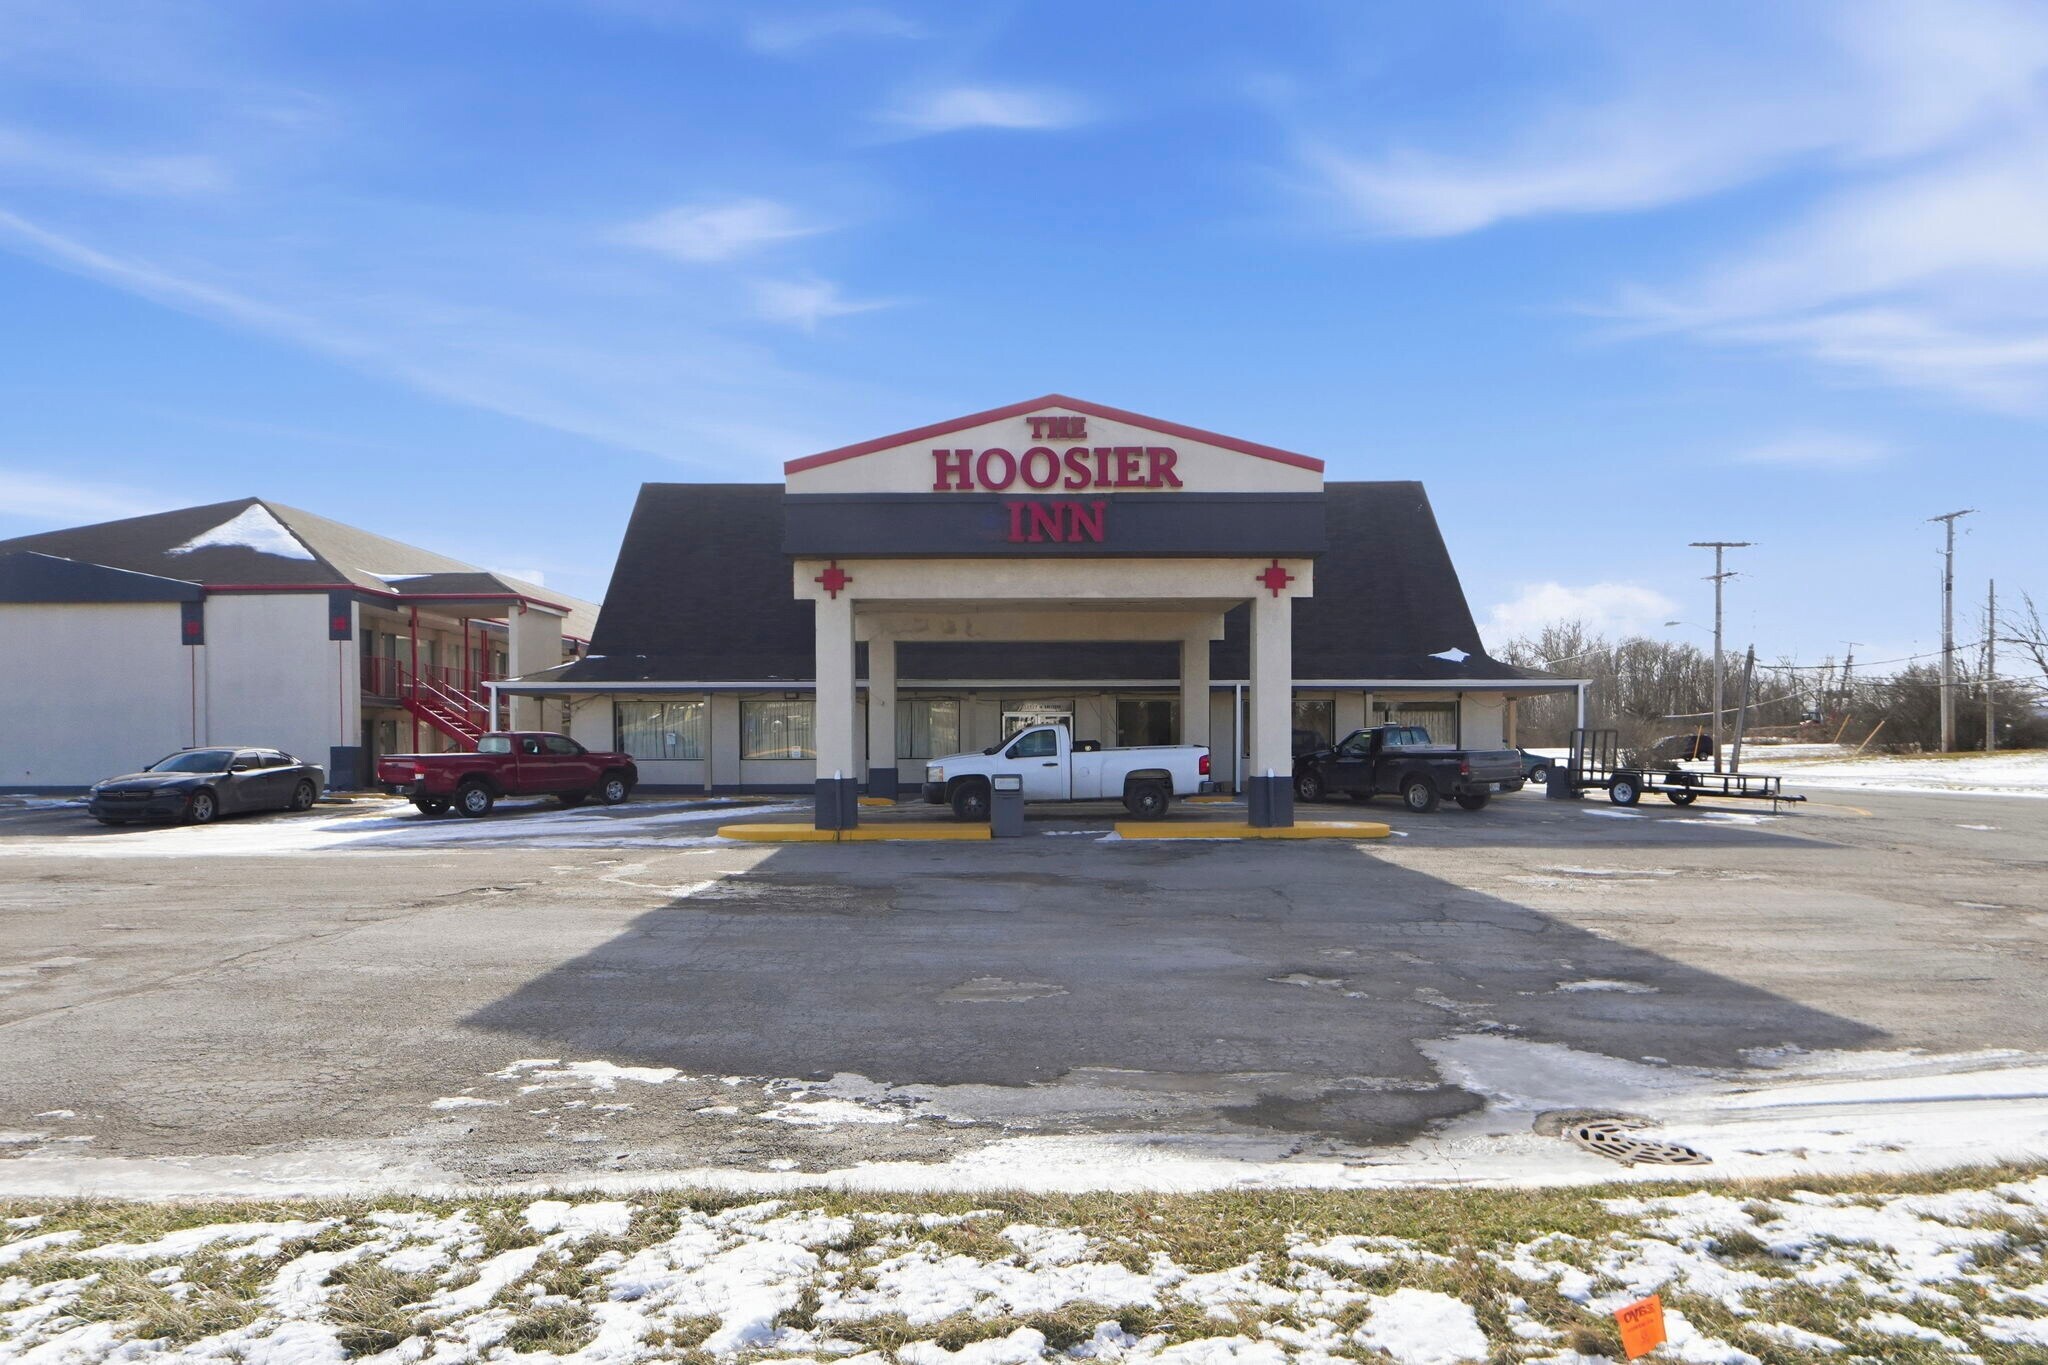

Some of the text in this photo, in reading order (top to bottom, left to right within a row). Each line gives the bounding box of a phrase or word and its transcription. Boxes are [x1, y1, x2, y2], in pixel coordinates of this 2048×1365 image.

[1026, 416, 1088, 439] THE
[932, 446, 1183, 490] HOOSIER
[1006, 501, 1107, 543] INN
